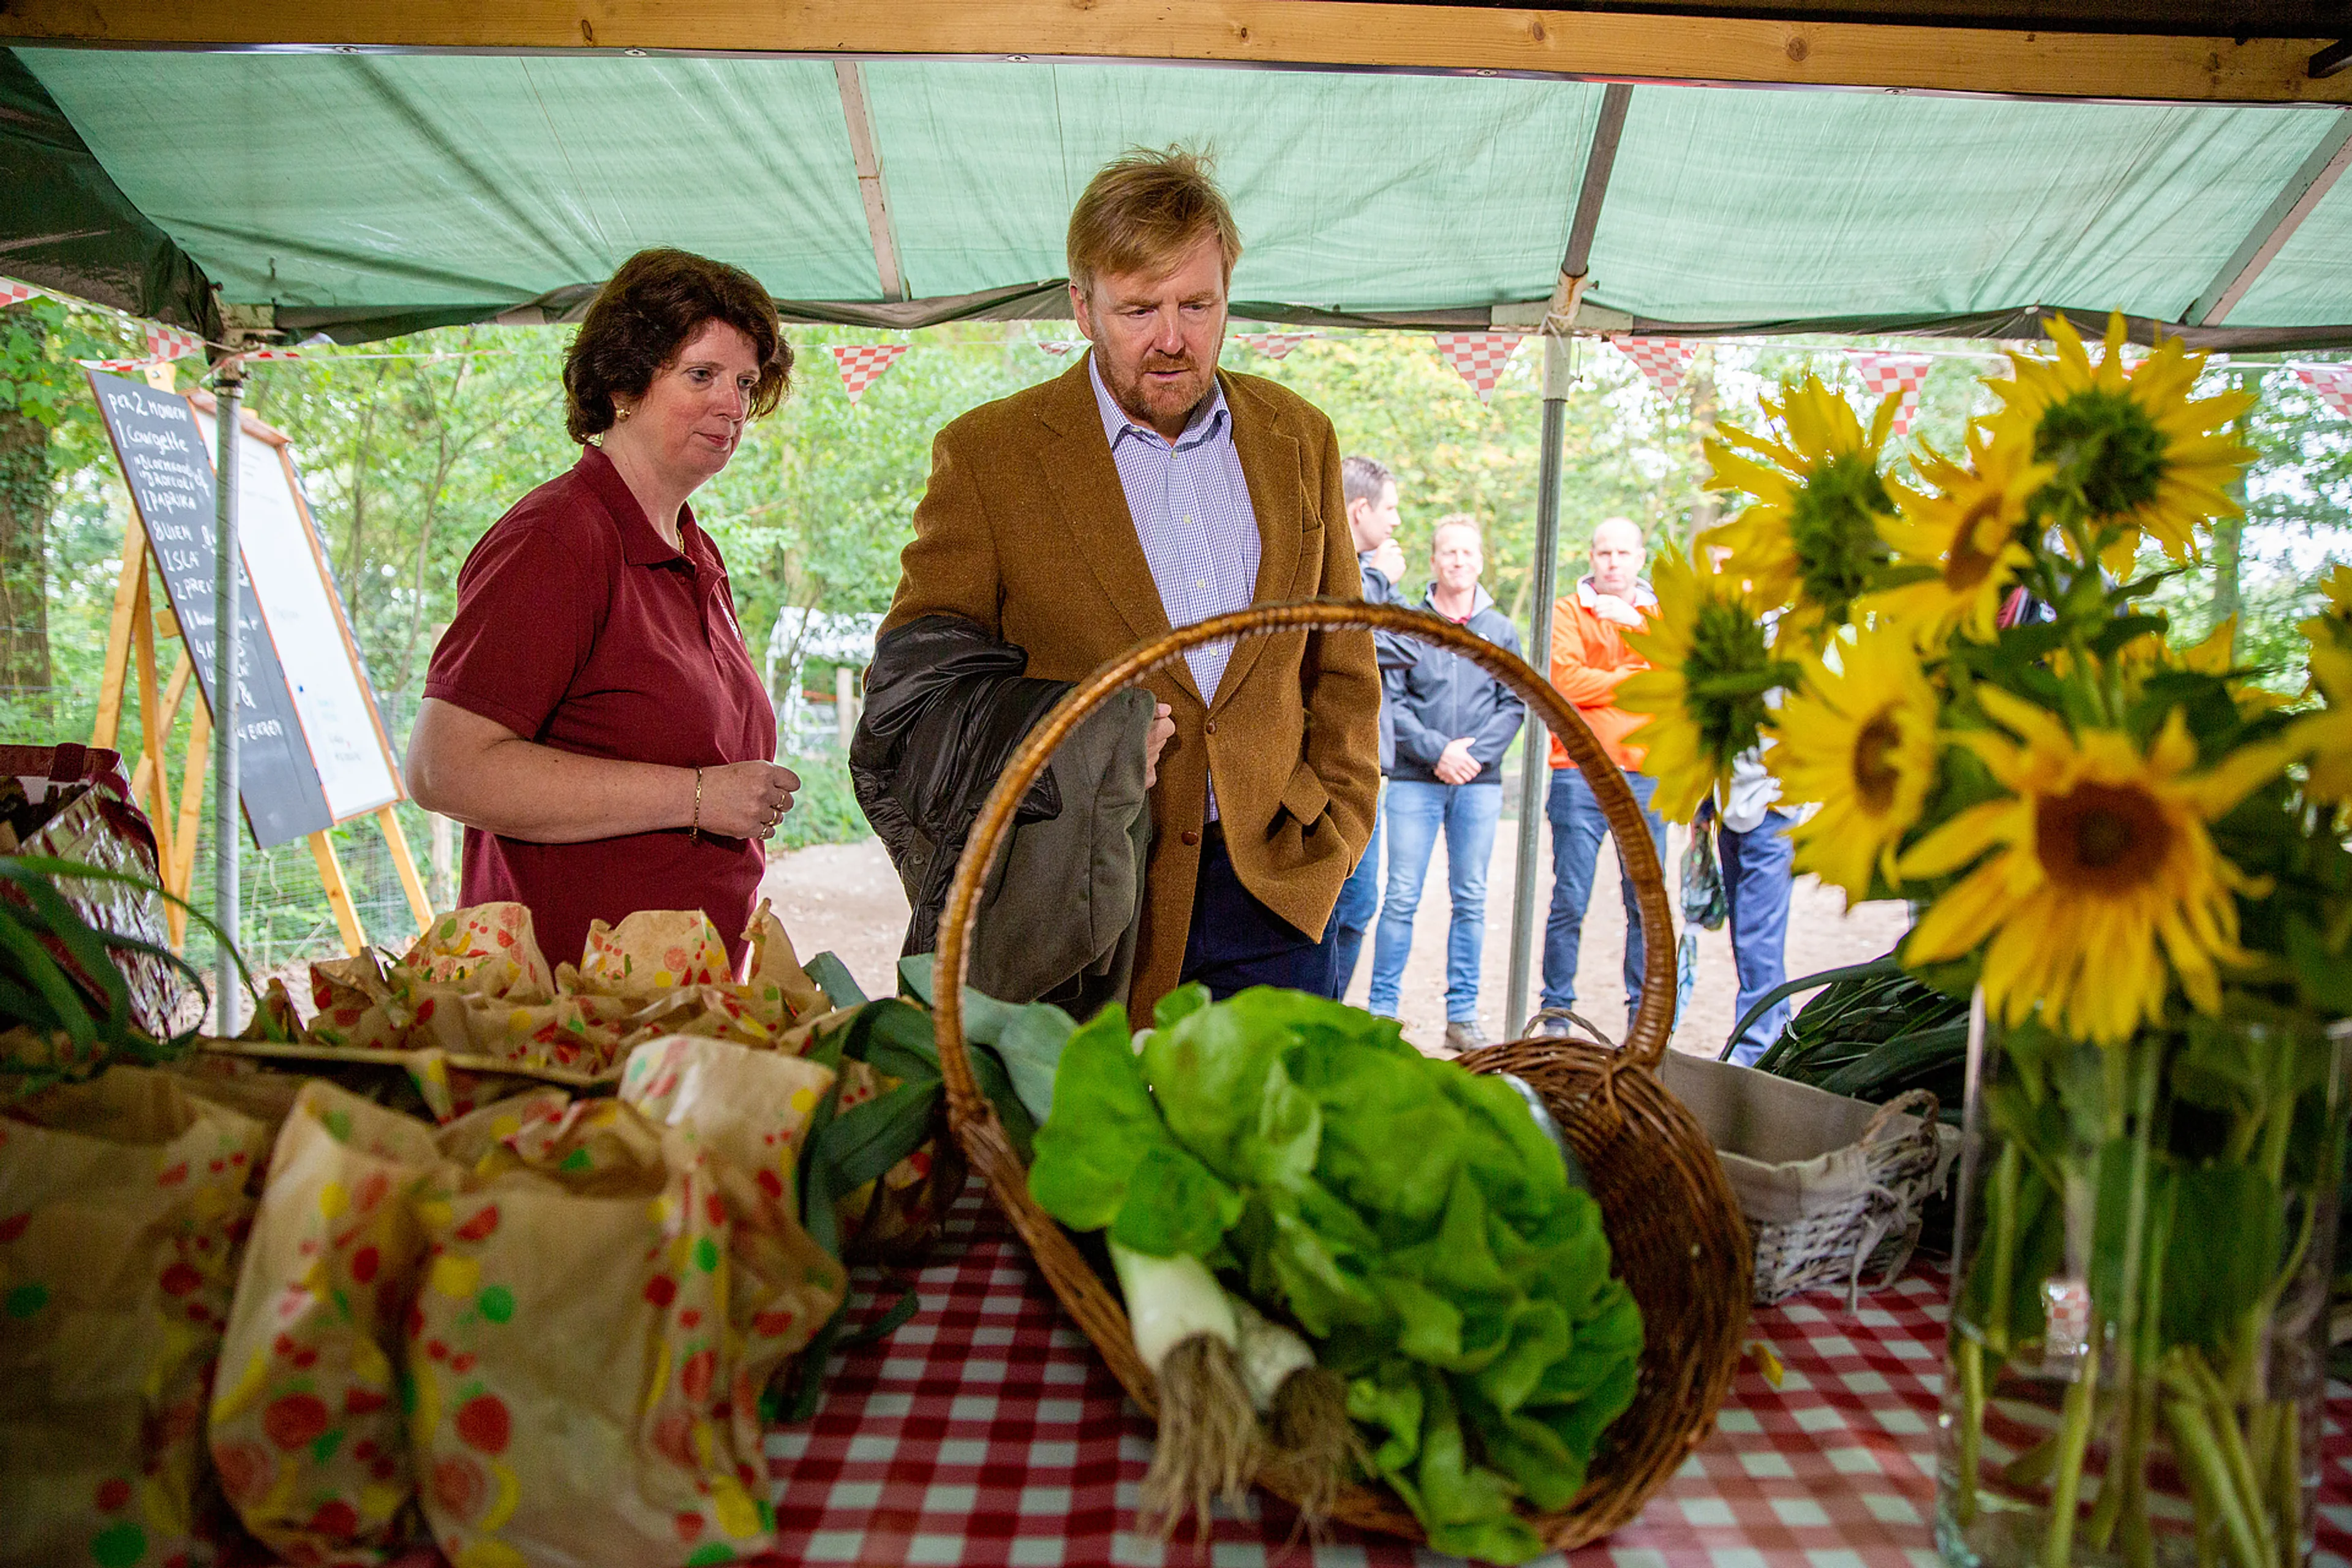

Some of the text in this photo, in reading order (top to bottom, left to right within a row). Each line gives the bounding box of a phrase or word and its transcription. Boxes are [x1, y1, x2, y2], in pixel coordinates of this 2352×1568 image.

[132, 391, 149, 416] 2
[115, 419, 128, 449] 1
[153, 521, 165, 541] 8
[164, 548, 200, 573] 1 SLA
[175, 582, 187, 600] 2
